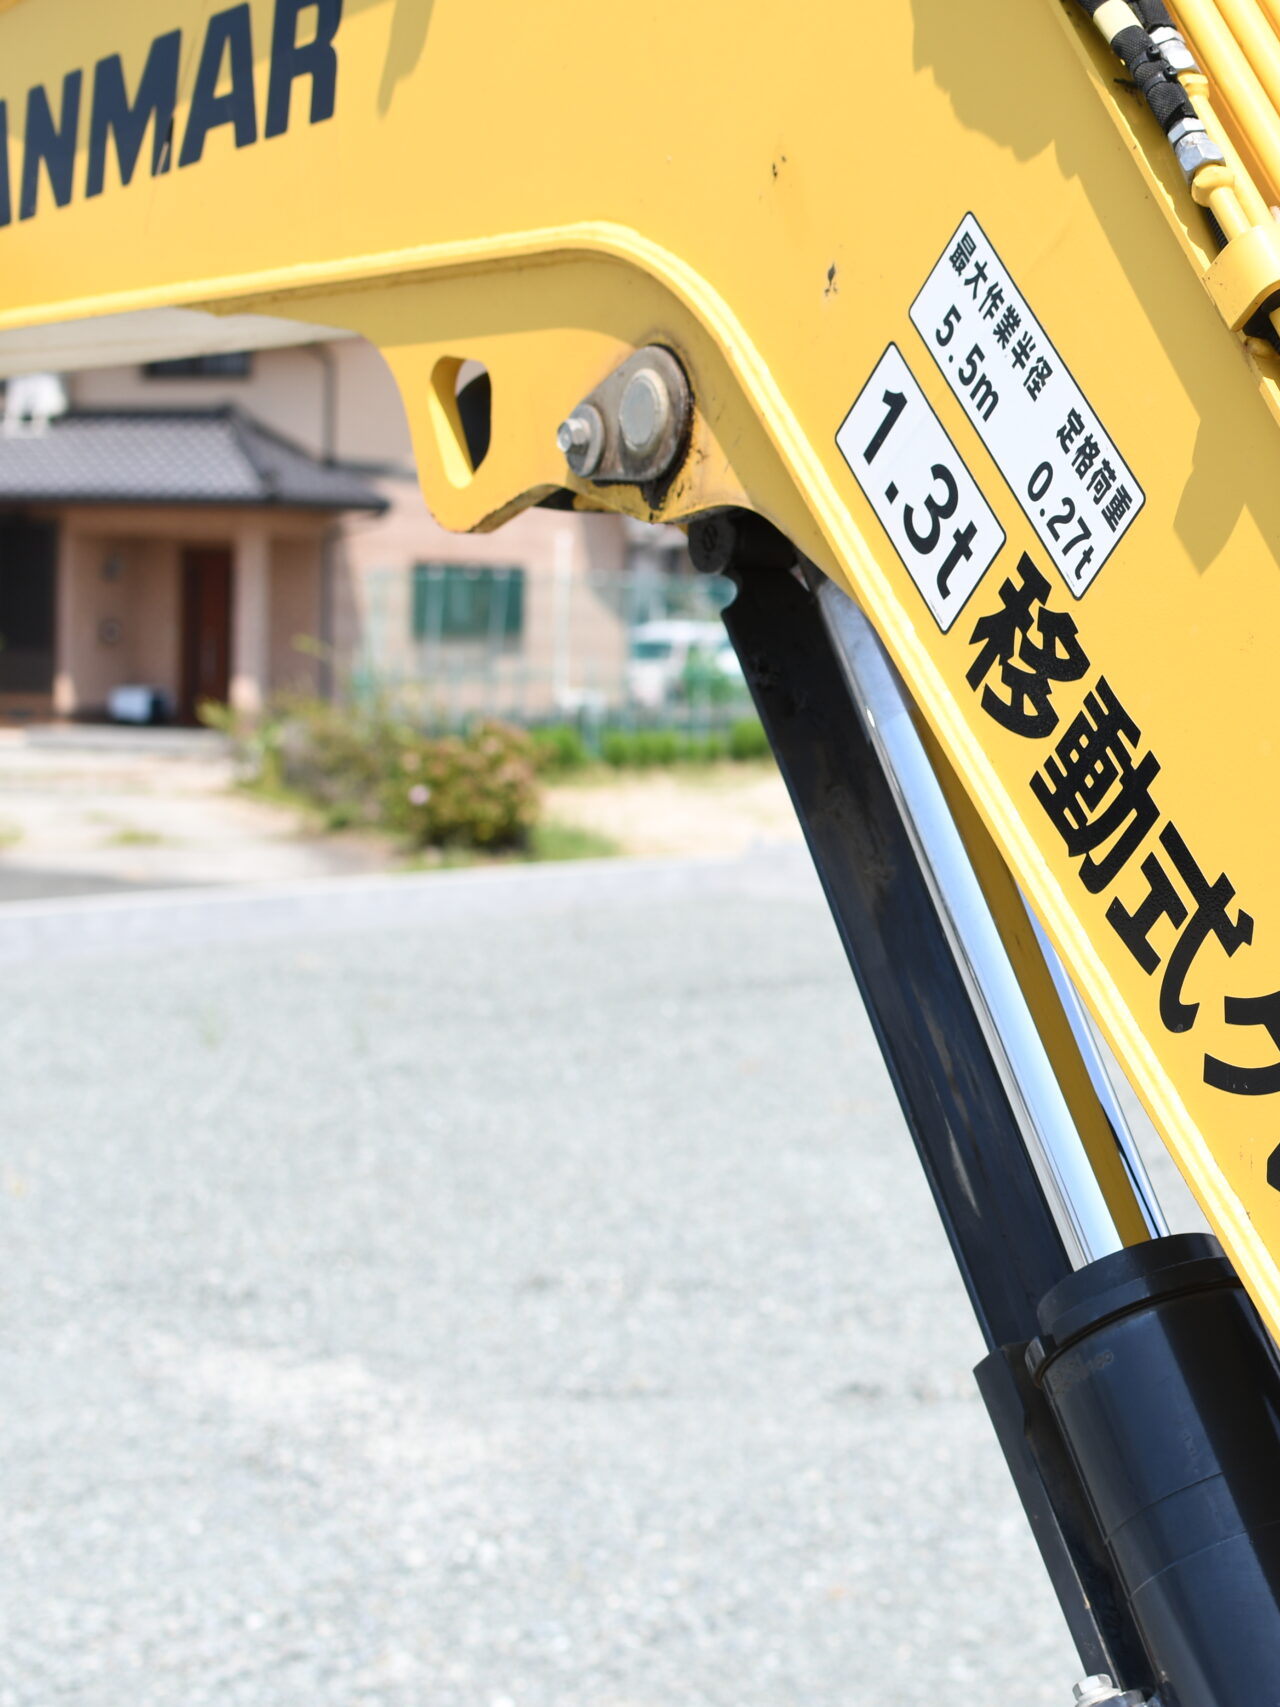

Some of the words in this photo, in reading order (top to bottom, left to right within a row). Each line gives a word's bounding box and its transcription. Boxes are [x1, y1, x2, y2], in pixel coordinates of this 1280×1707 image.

[862, 389, 978, 600] 1.3t
[935, 304, 1000, 422] 5.5m
[1027, 460, 1096, 580] 0.27t
[948, 231, 1054, 402] 最大作業半径
[1056, 407, 1133, 533] 定格荷重
